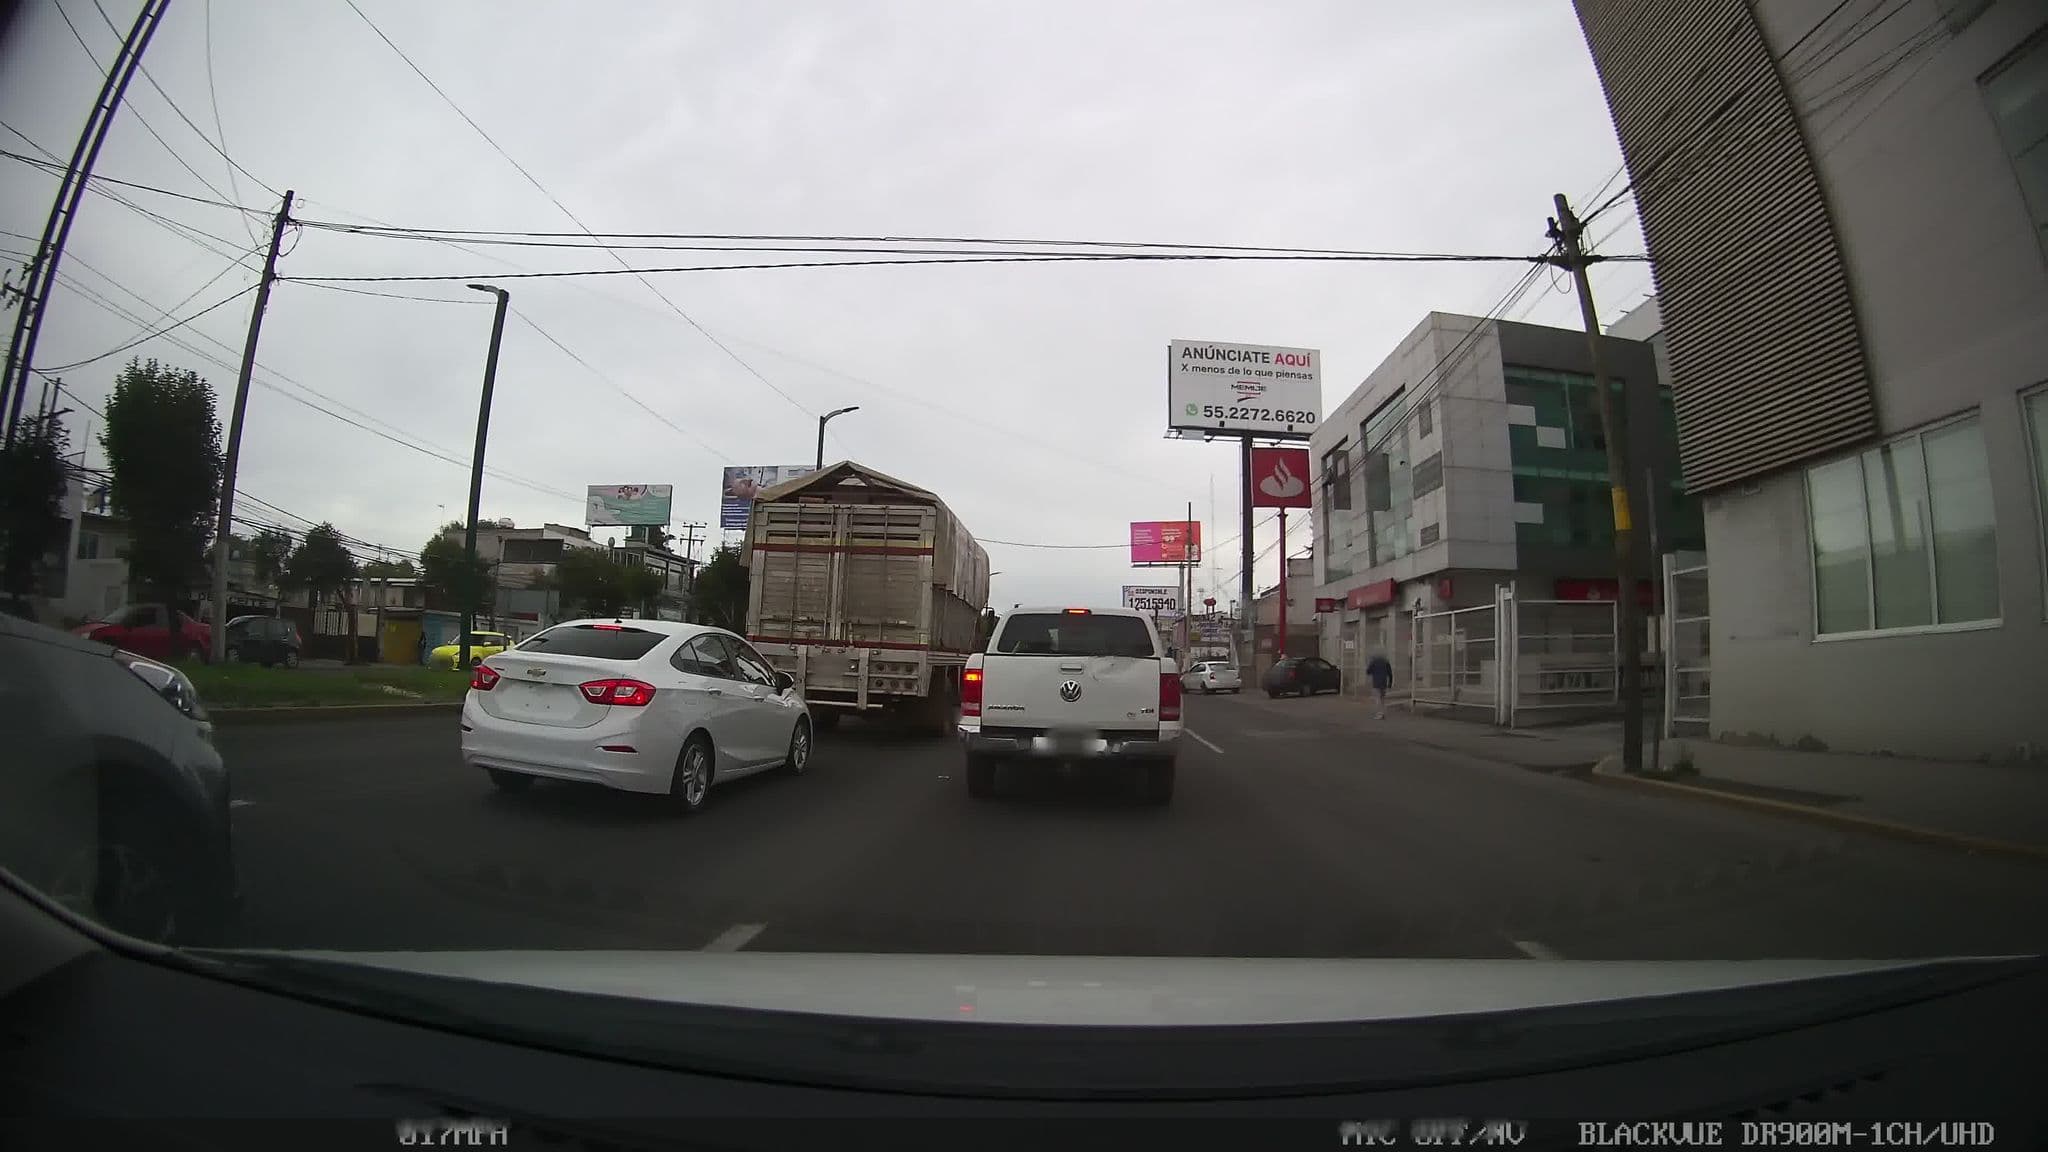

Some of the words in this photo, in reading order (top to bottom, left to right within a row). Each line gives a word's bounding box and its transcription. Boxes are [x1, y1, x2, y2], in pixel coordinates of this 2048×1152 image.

[1182, 345, 1271, 364] ANÚNCIATE
[1274, 352, 1311, 368] AQUÍ
[1181, 363, 1189, 372] X
[1191, 365, 1226, 374] menos
[1228, 366, 1241, 375] de
[1243, 367, 1252, 376] lo
[1254, 369, 1273, 379] que
[1276, 369, 1313, 380] piensas
[1203, 405, 1316, 424] 55.2272.6620
